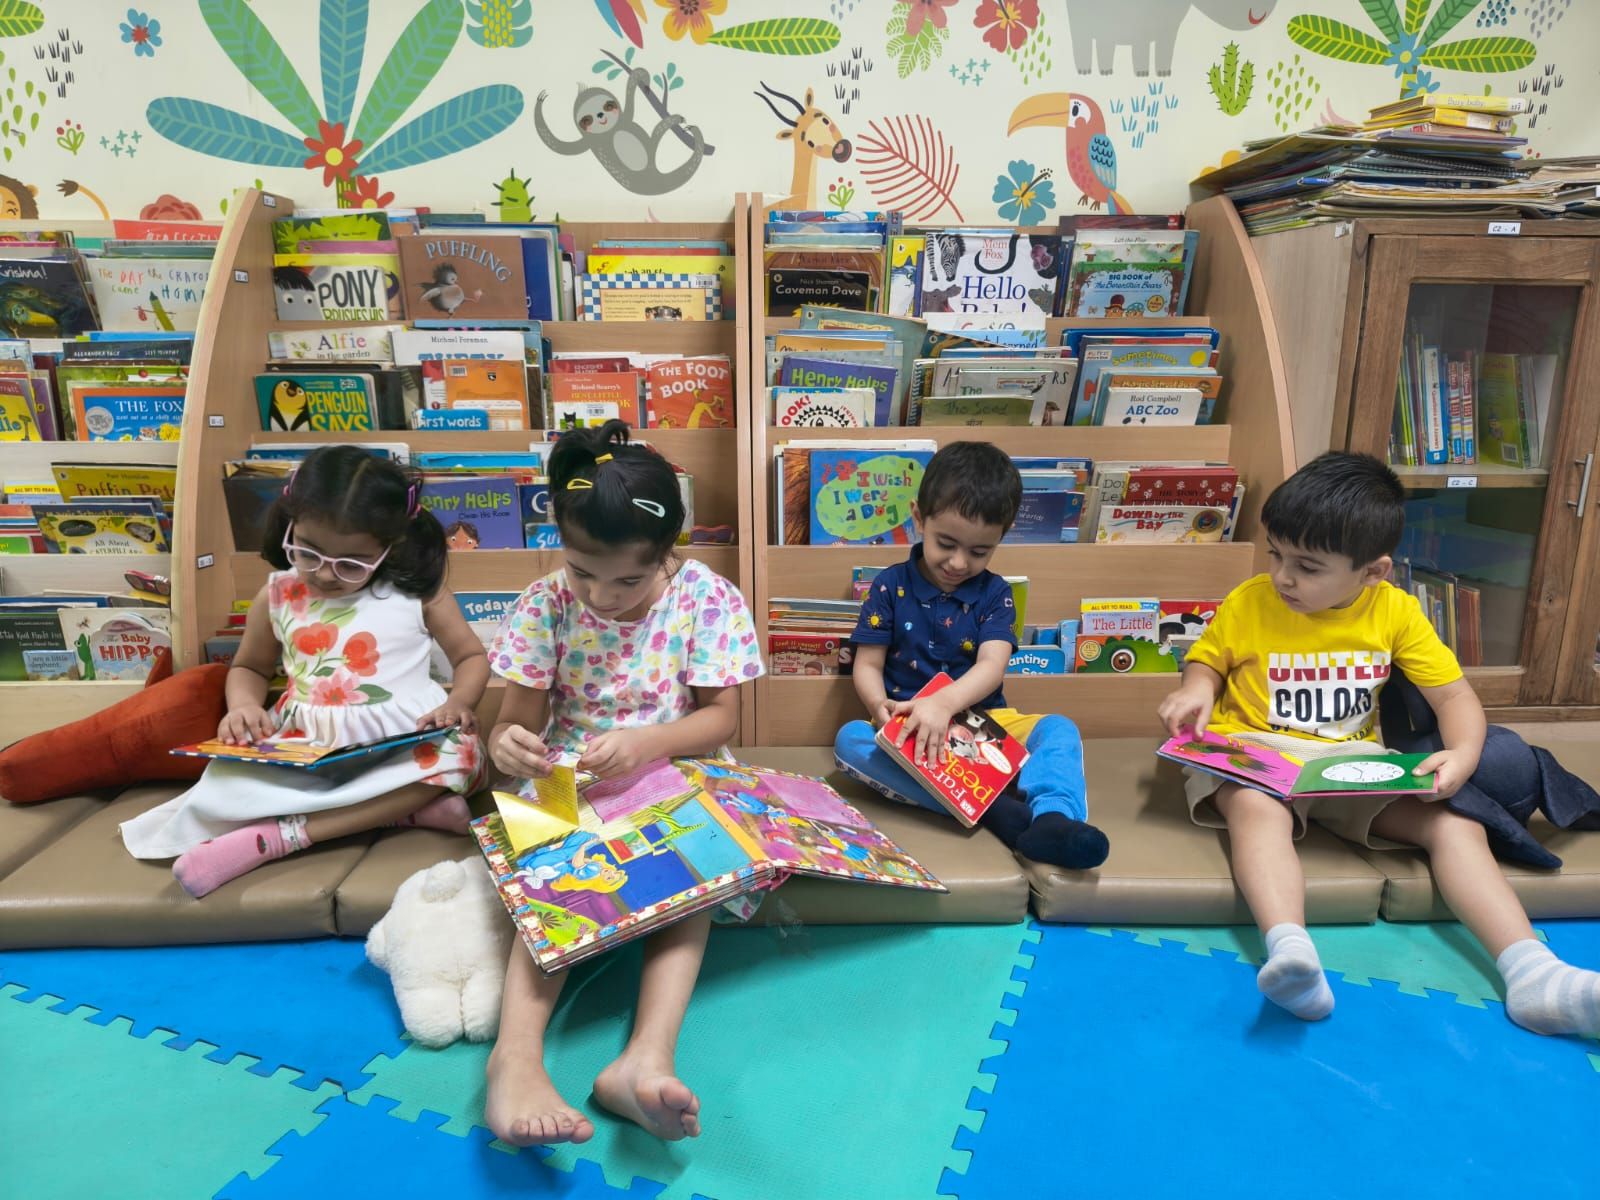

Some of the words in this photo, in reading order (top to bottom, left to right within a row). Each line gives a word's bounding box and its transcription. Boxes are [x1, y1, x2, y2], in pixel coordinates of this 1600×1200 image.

[982, 239, 1008, 249] Mem
[424, 239, 512, 282] PUFFLING
[985, 249, 1003, 260] Fox
[120, 270, 144, 285] DAY
[318, 269, 378, 308] PONY
[775, 285, 829, 296] Caveman
[831, 285, 862, 297] Dave
[960, 275, 1026, 300] Hello
[317, 332, 367, 352] Alfie
[431, 335, 458, 344] Michael
[658, 366, 682, 377] THE
[685, 362, 729, 380] FOOT
[791, 368, 842, 388] Henry
[846, 375, 889, 393] Helps
[659, 379, 709, 399] BOOK
[114, 400, 149, 413] THE
[153, 400, 184, 413] FOX
[305, 390, 368, 414] PENGUIN
[1130, 394, 1145, 402] Rod
[1147, 394, 1182, 403] Campbell
[781, 395, 812, 426] OOK!
[1126, 405, 1153, 415] ABC
[1155, 405, 1179, 415] Zoo
[311, 413, 369, 431] SAYS
[446, 416, 481, 428] words
[873, 470, 912, 487] Wish
[76, 482, 132, 496] Puffin
[833, 490, 841, 505] I
[843, 488, 889, 505] Were
[420, 494, 461, 512] enry
[464, 489, 512, 510] Helps
[860, 503, 898, 527] Dog
[1112, 508, 1153, 519] Down
[1154, 511, 1166, 519] by
[1136, 519, 1164, 532] Bay
[464, 600, 513, 616] Today
[1091, 618, 1116, 631] The
[1119, 616, 1153, 631] Little
[120, 633, 151, 645] Baby
[99, 645, 170, 661] HIPPO
[1008, 653, 1049, 668] anting
[1268, 651, 1392, 682] UNITED
